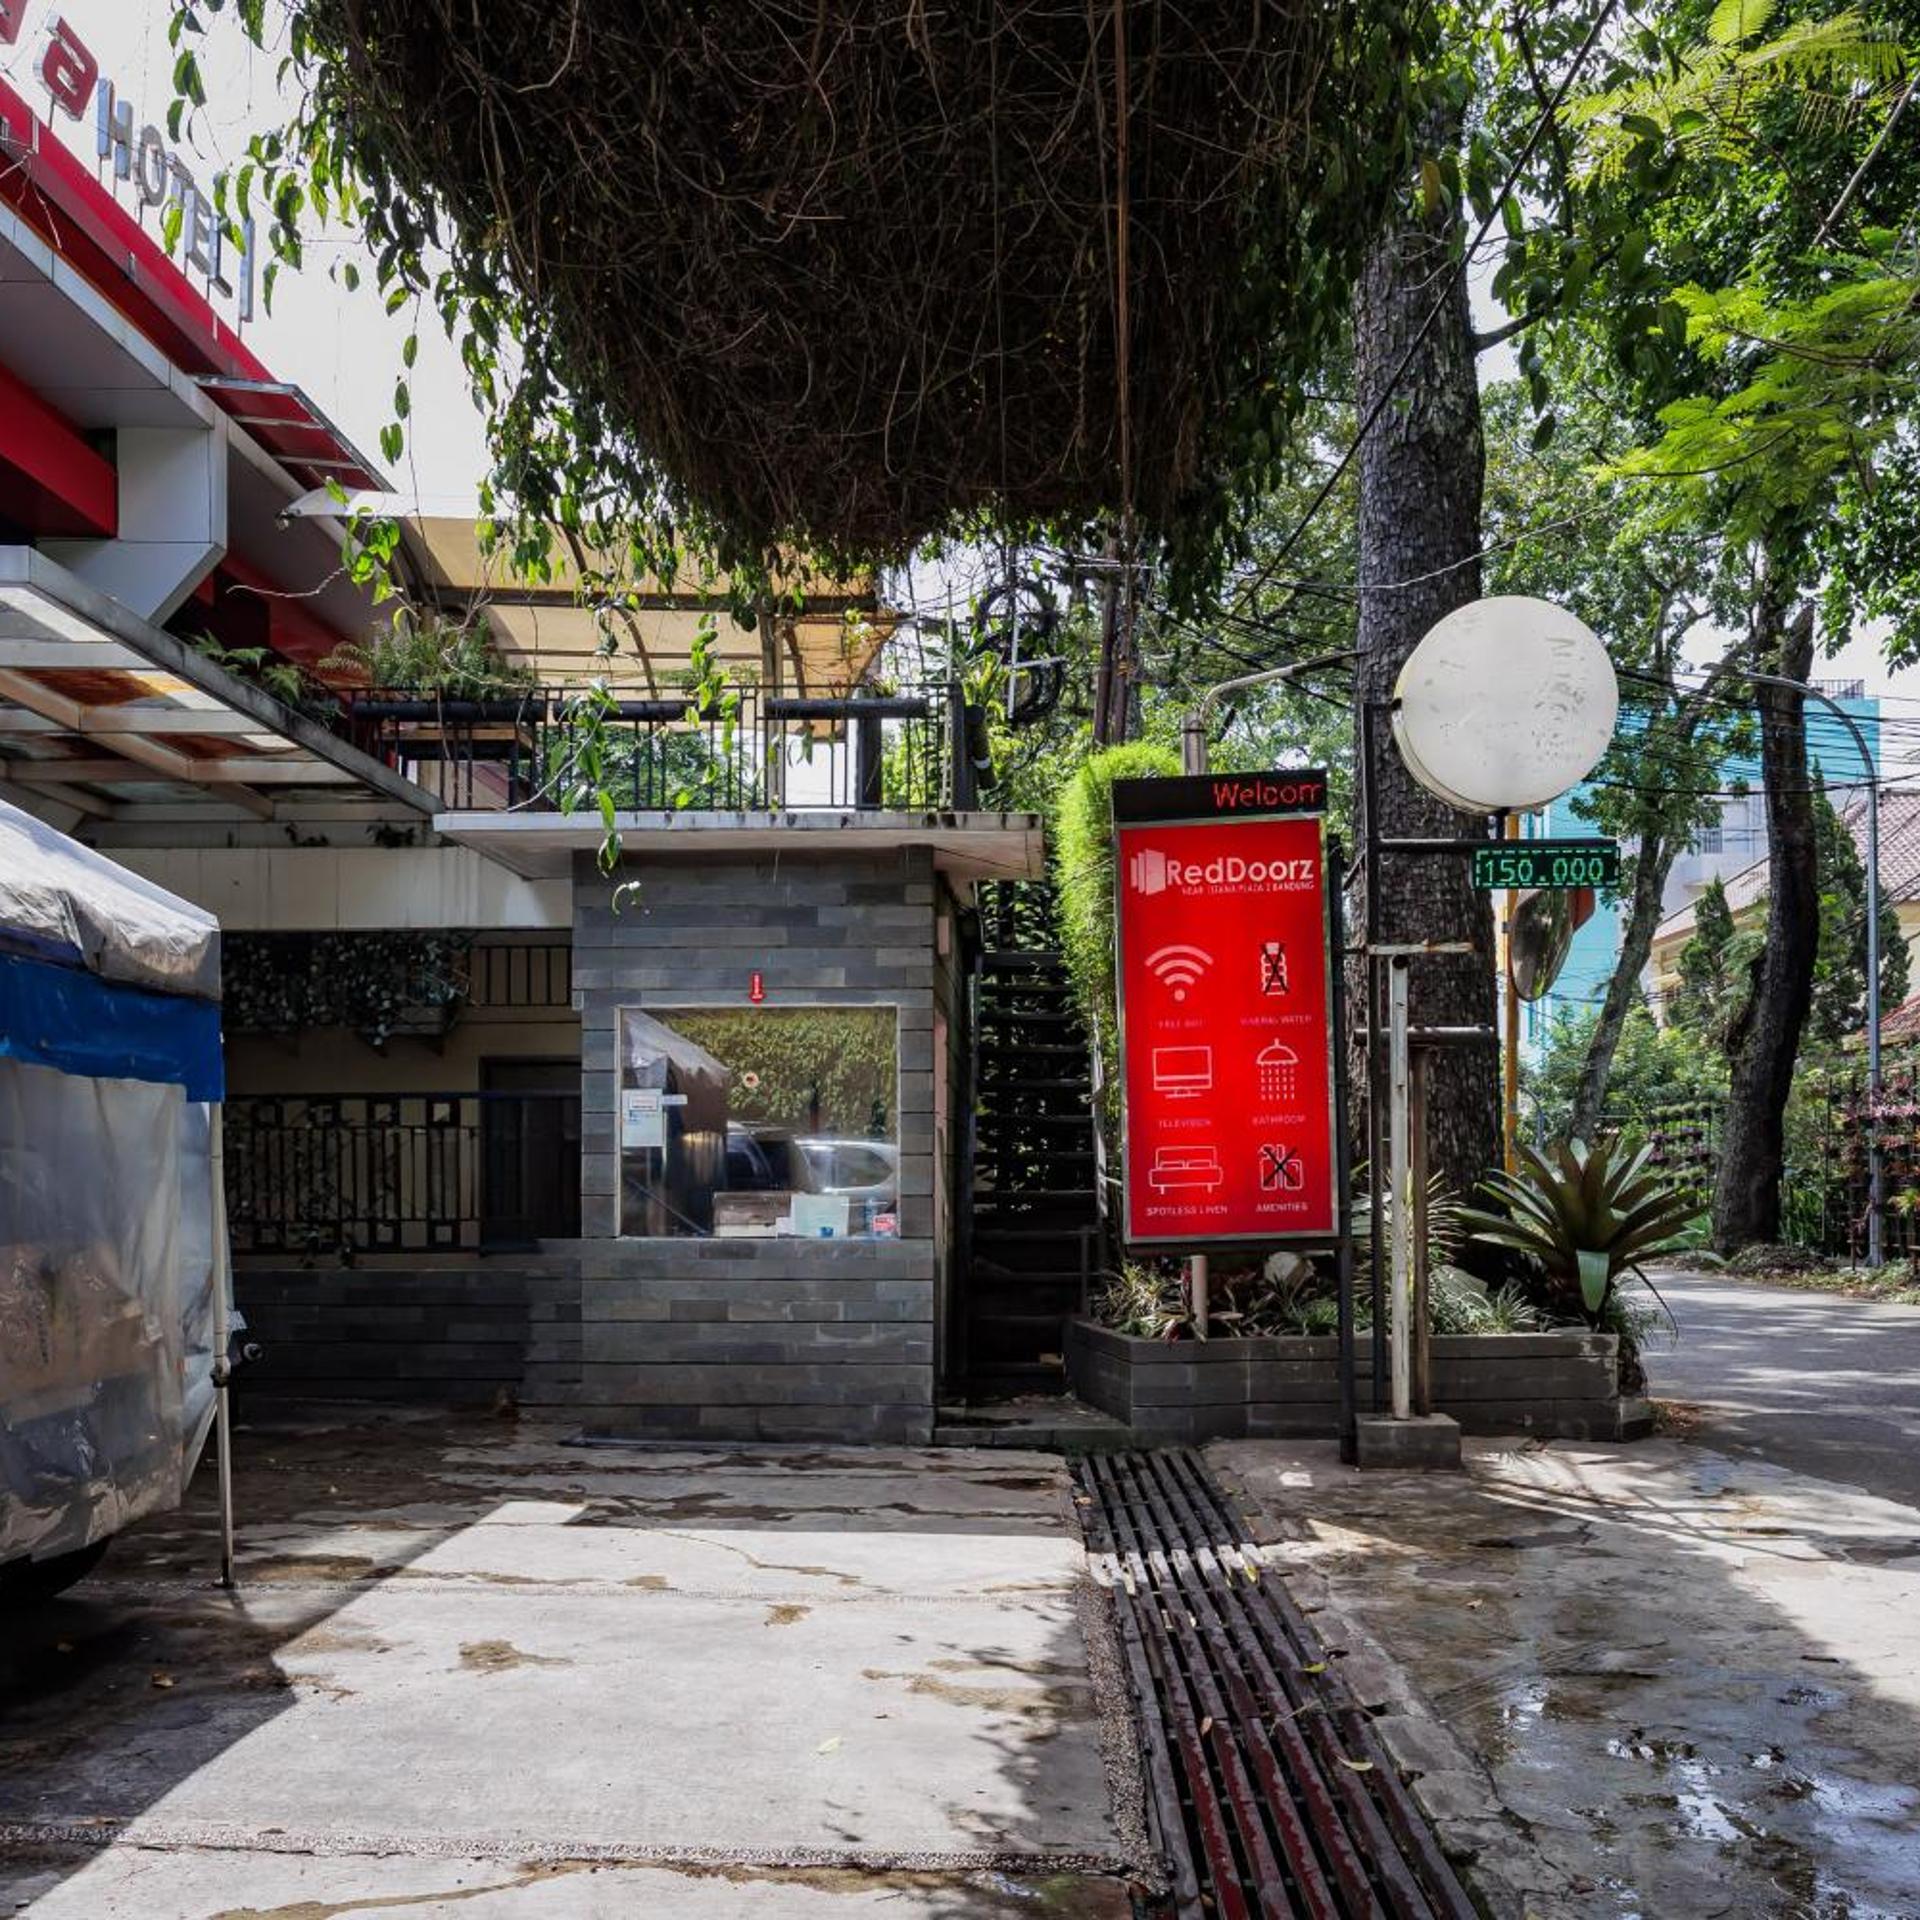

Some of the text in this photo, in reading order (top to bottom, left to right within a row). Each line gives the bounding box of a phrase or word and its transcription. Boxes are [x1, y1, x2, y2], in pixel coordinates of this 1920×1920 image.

[1167, 857, 1314, 886] RedDoorz
[1485, 858, 1604, 882] 150.000
[1272, 881, 1315, 891] BANDUNG
[1147, 1206, 1197, 1217] SPOTLESS
[1256, 1202, 1309, 1213] AMENITIES
